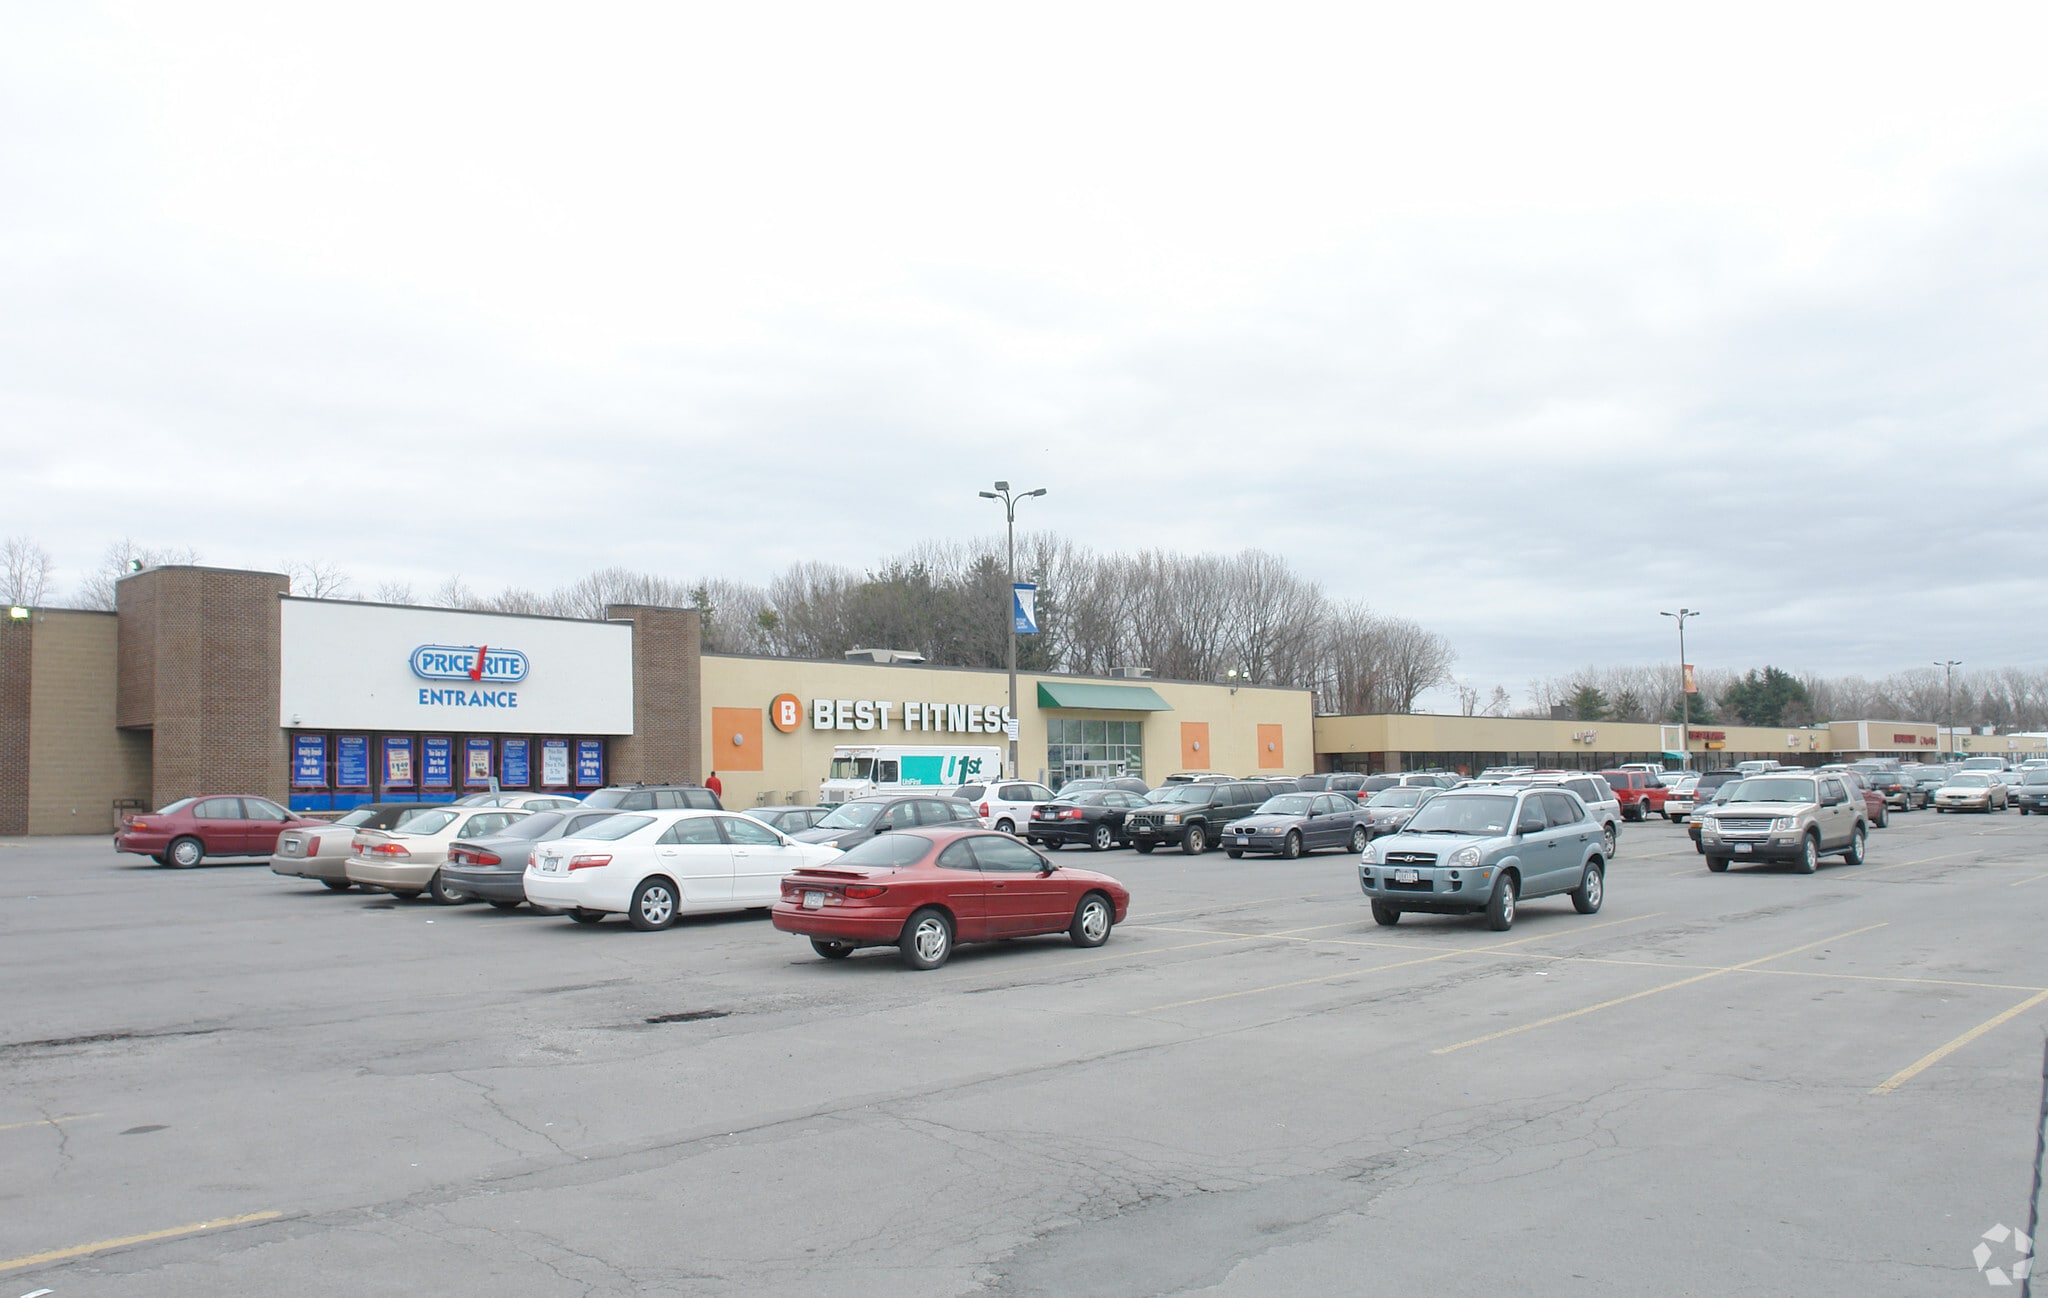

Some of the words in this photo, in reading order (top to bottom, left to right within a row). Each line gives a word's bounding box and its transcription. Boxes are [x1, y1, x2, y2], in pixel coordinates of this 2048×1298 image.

[423, 653, 473, 673] PRICE
[482, 656, 520, 675] RITE
[419, 688, 518, 708] ENTRANCE
[812, 699, 893, 731] BEST
